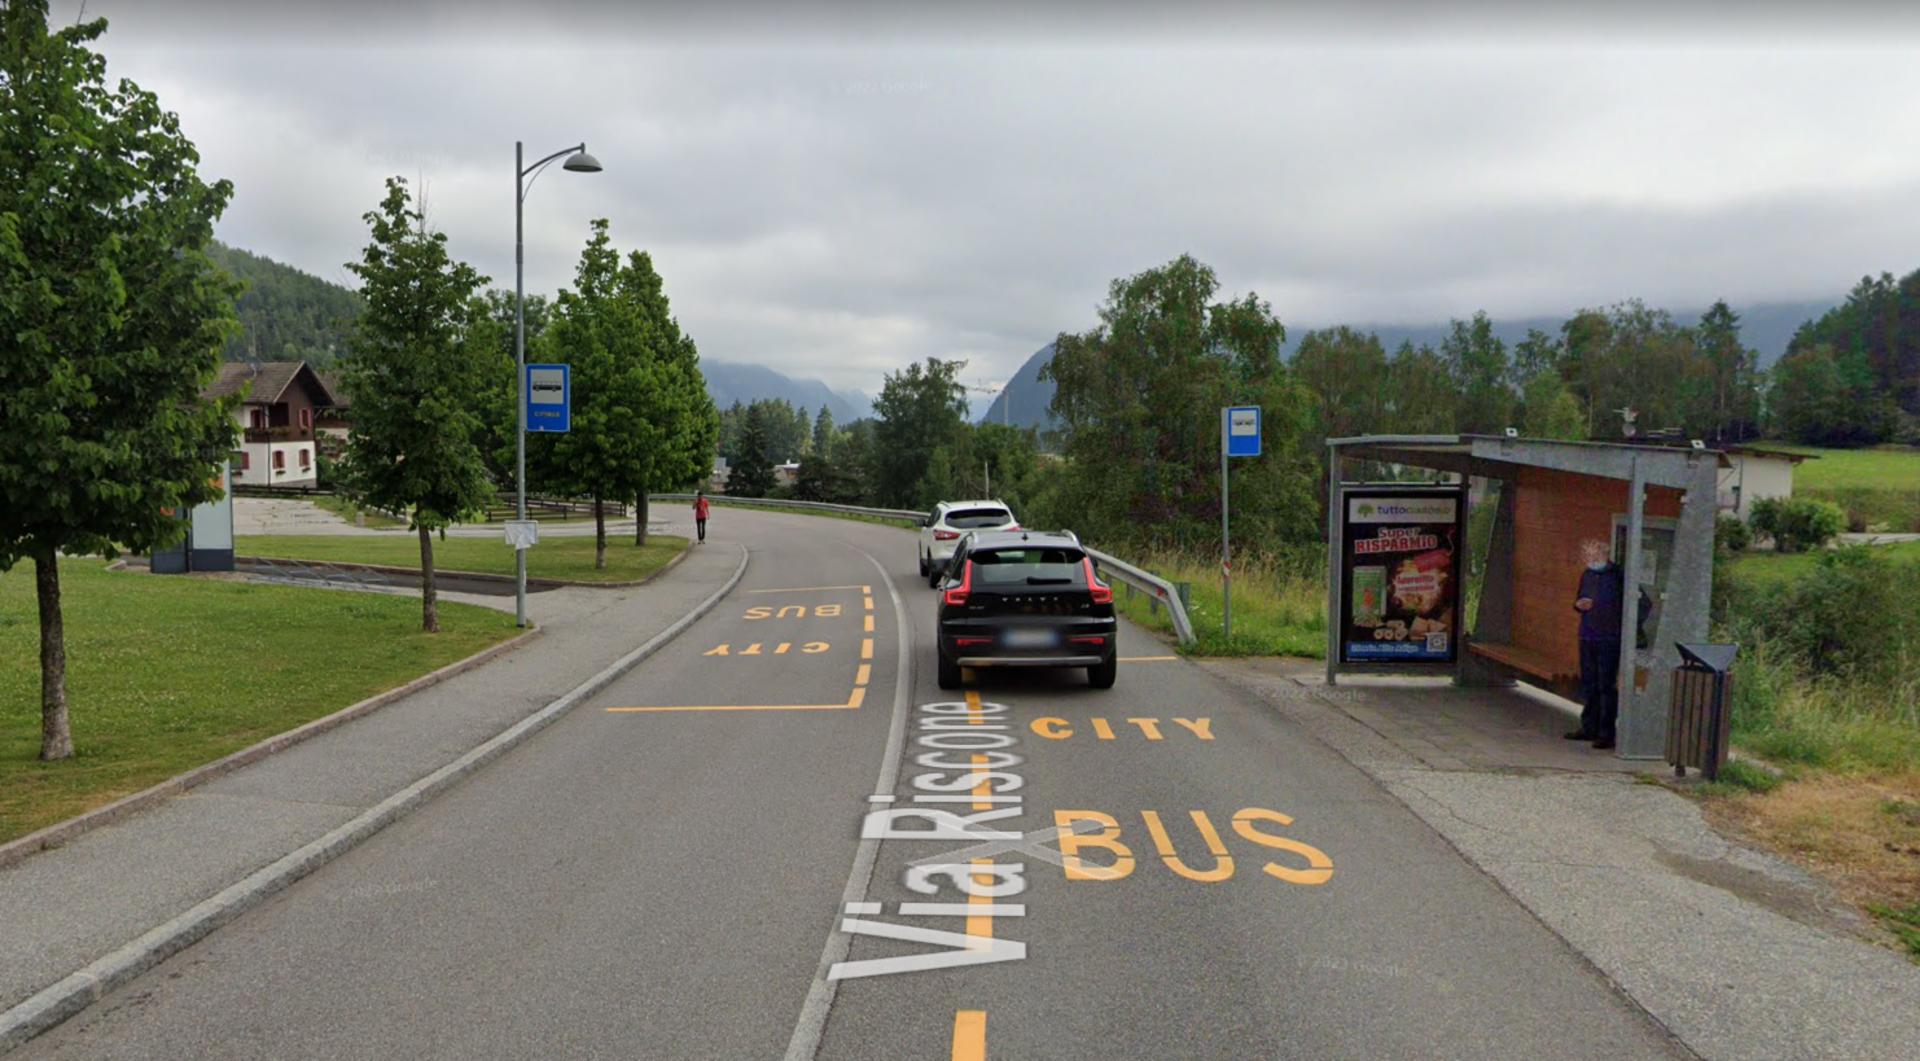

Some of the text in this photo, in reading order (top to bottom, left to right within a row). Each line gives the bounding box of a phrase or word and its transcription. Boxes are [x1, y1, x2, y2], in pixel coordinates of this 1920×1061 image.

[1378, 527, 1421, 540] Super
[1355, 535, 1438, 553] RISPARMIO
[742, 604, 842, 620] BUS
[703, 641, 830, 656] CITY
[1030, 717, 1217, 740] CITY
[1053, 807, 1335, 885] BUS
